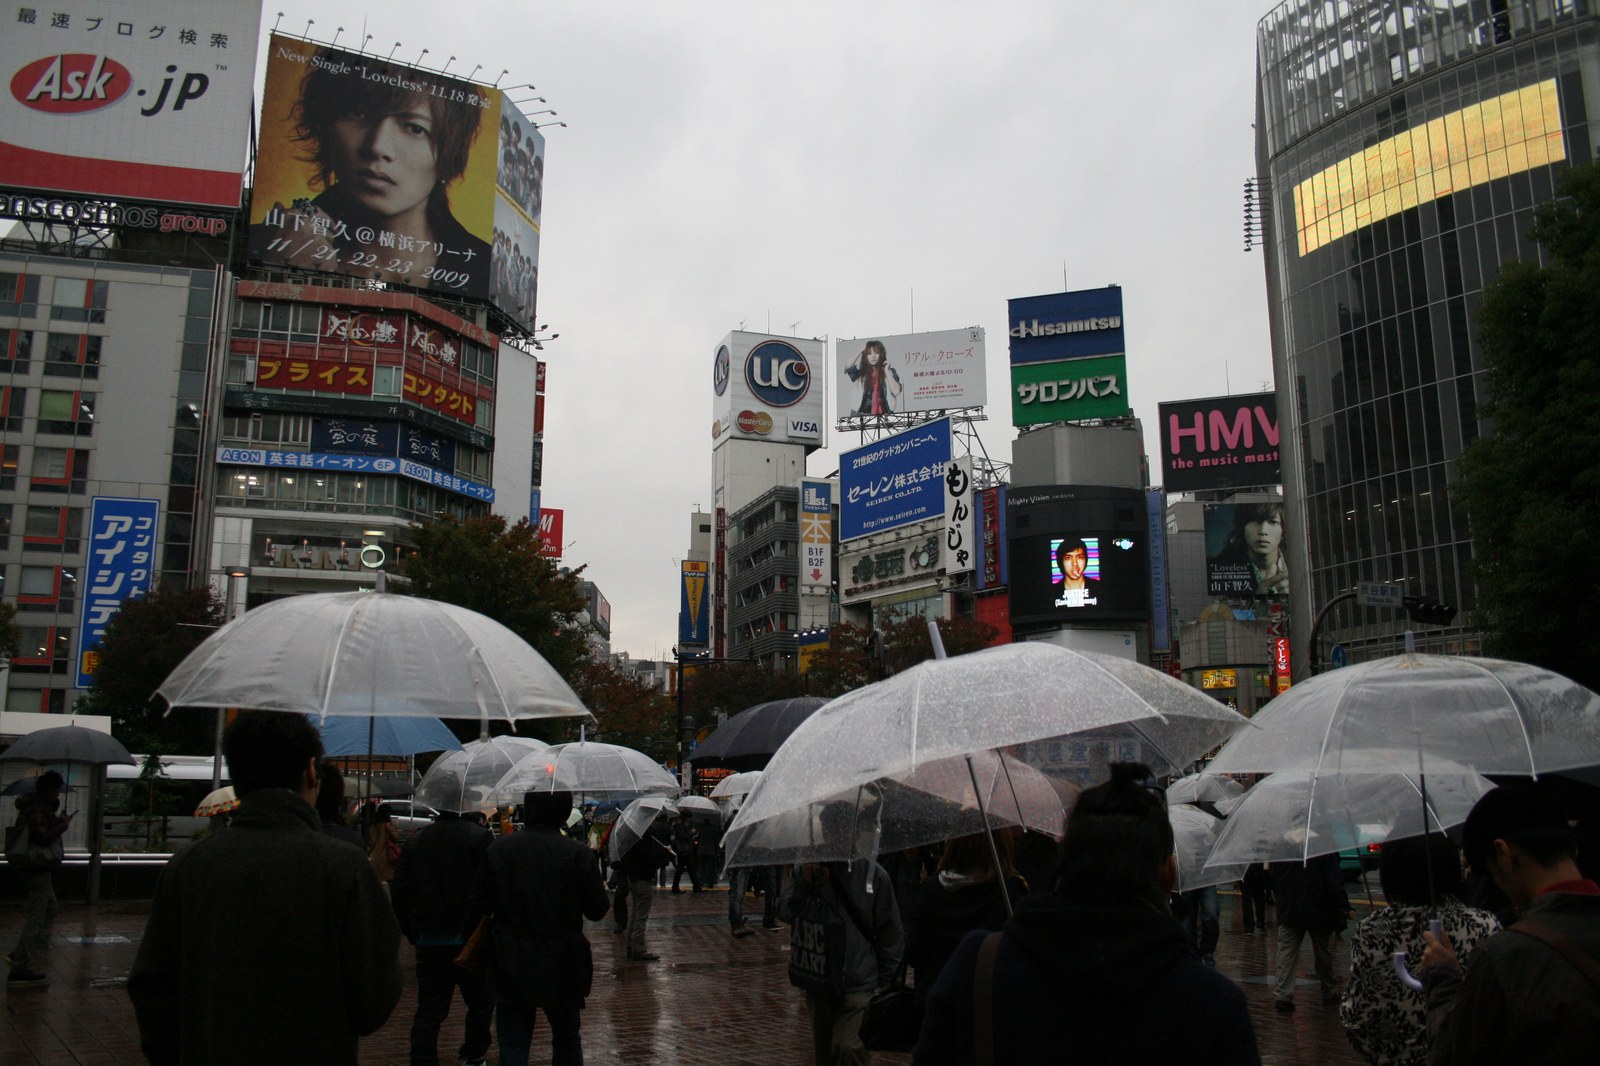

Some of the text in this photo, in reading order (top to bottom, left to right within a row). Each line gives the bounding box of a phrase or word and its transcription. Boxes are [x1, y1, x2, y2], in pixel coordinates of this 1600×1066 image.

[18, 7, 229, 50] 最速ブログ検索
[276, 47, 308, 64] New
[310, 55, 351, 75] Single
[160, 213, 226, 235] group
[421, 266, 470, 288] 2009
[1009, 315, 1121, 338] Hisamitsu
[259, 359, 369, 388] プライス
[403, 372, 474, 416] コンタクト
[1017, 374, 1121, 405] サロンパス
[791, 420, 819, 434] VISA
[222, 448, 391, 471] AEON 英会話イーオン 6F
[1172, 458, 1194, 469] the
[1199, 453, 1238, 467] music
[404, 462, 494, 500] AEON 英会話イーオン
[847, 462, 944, 504] セーレン株式会社
[866, 494, 894, 508] SEIREN
[1029, 494, 1050, 504] Vision
[863, 505, 927, 529] http://www.seiren.com
[946, 463, 969, 567] もんじゃ
[130, 517, 153, 599] コンタクト
[808, 547, 824, 556] B1F
[808, 557, 824, 567] B2F
[1209, 562, 1251, 572] "Loveless"
[1210, 581, 1254, 592] 山下智久
[1360, 584, 1399, 598] 渋谷駅前
